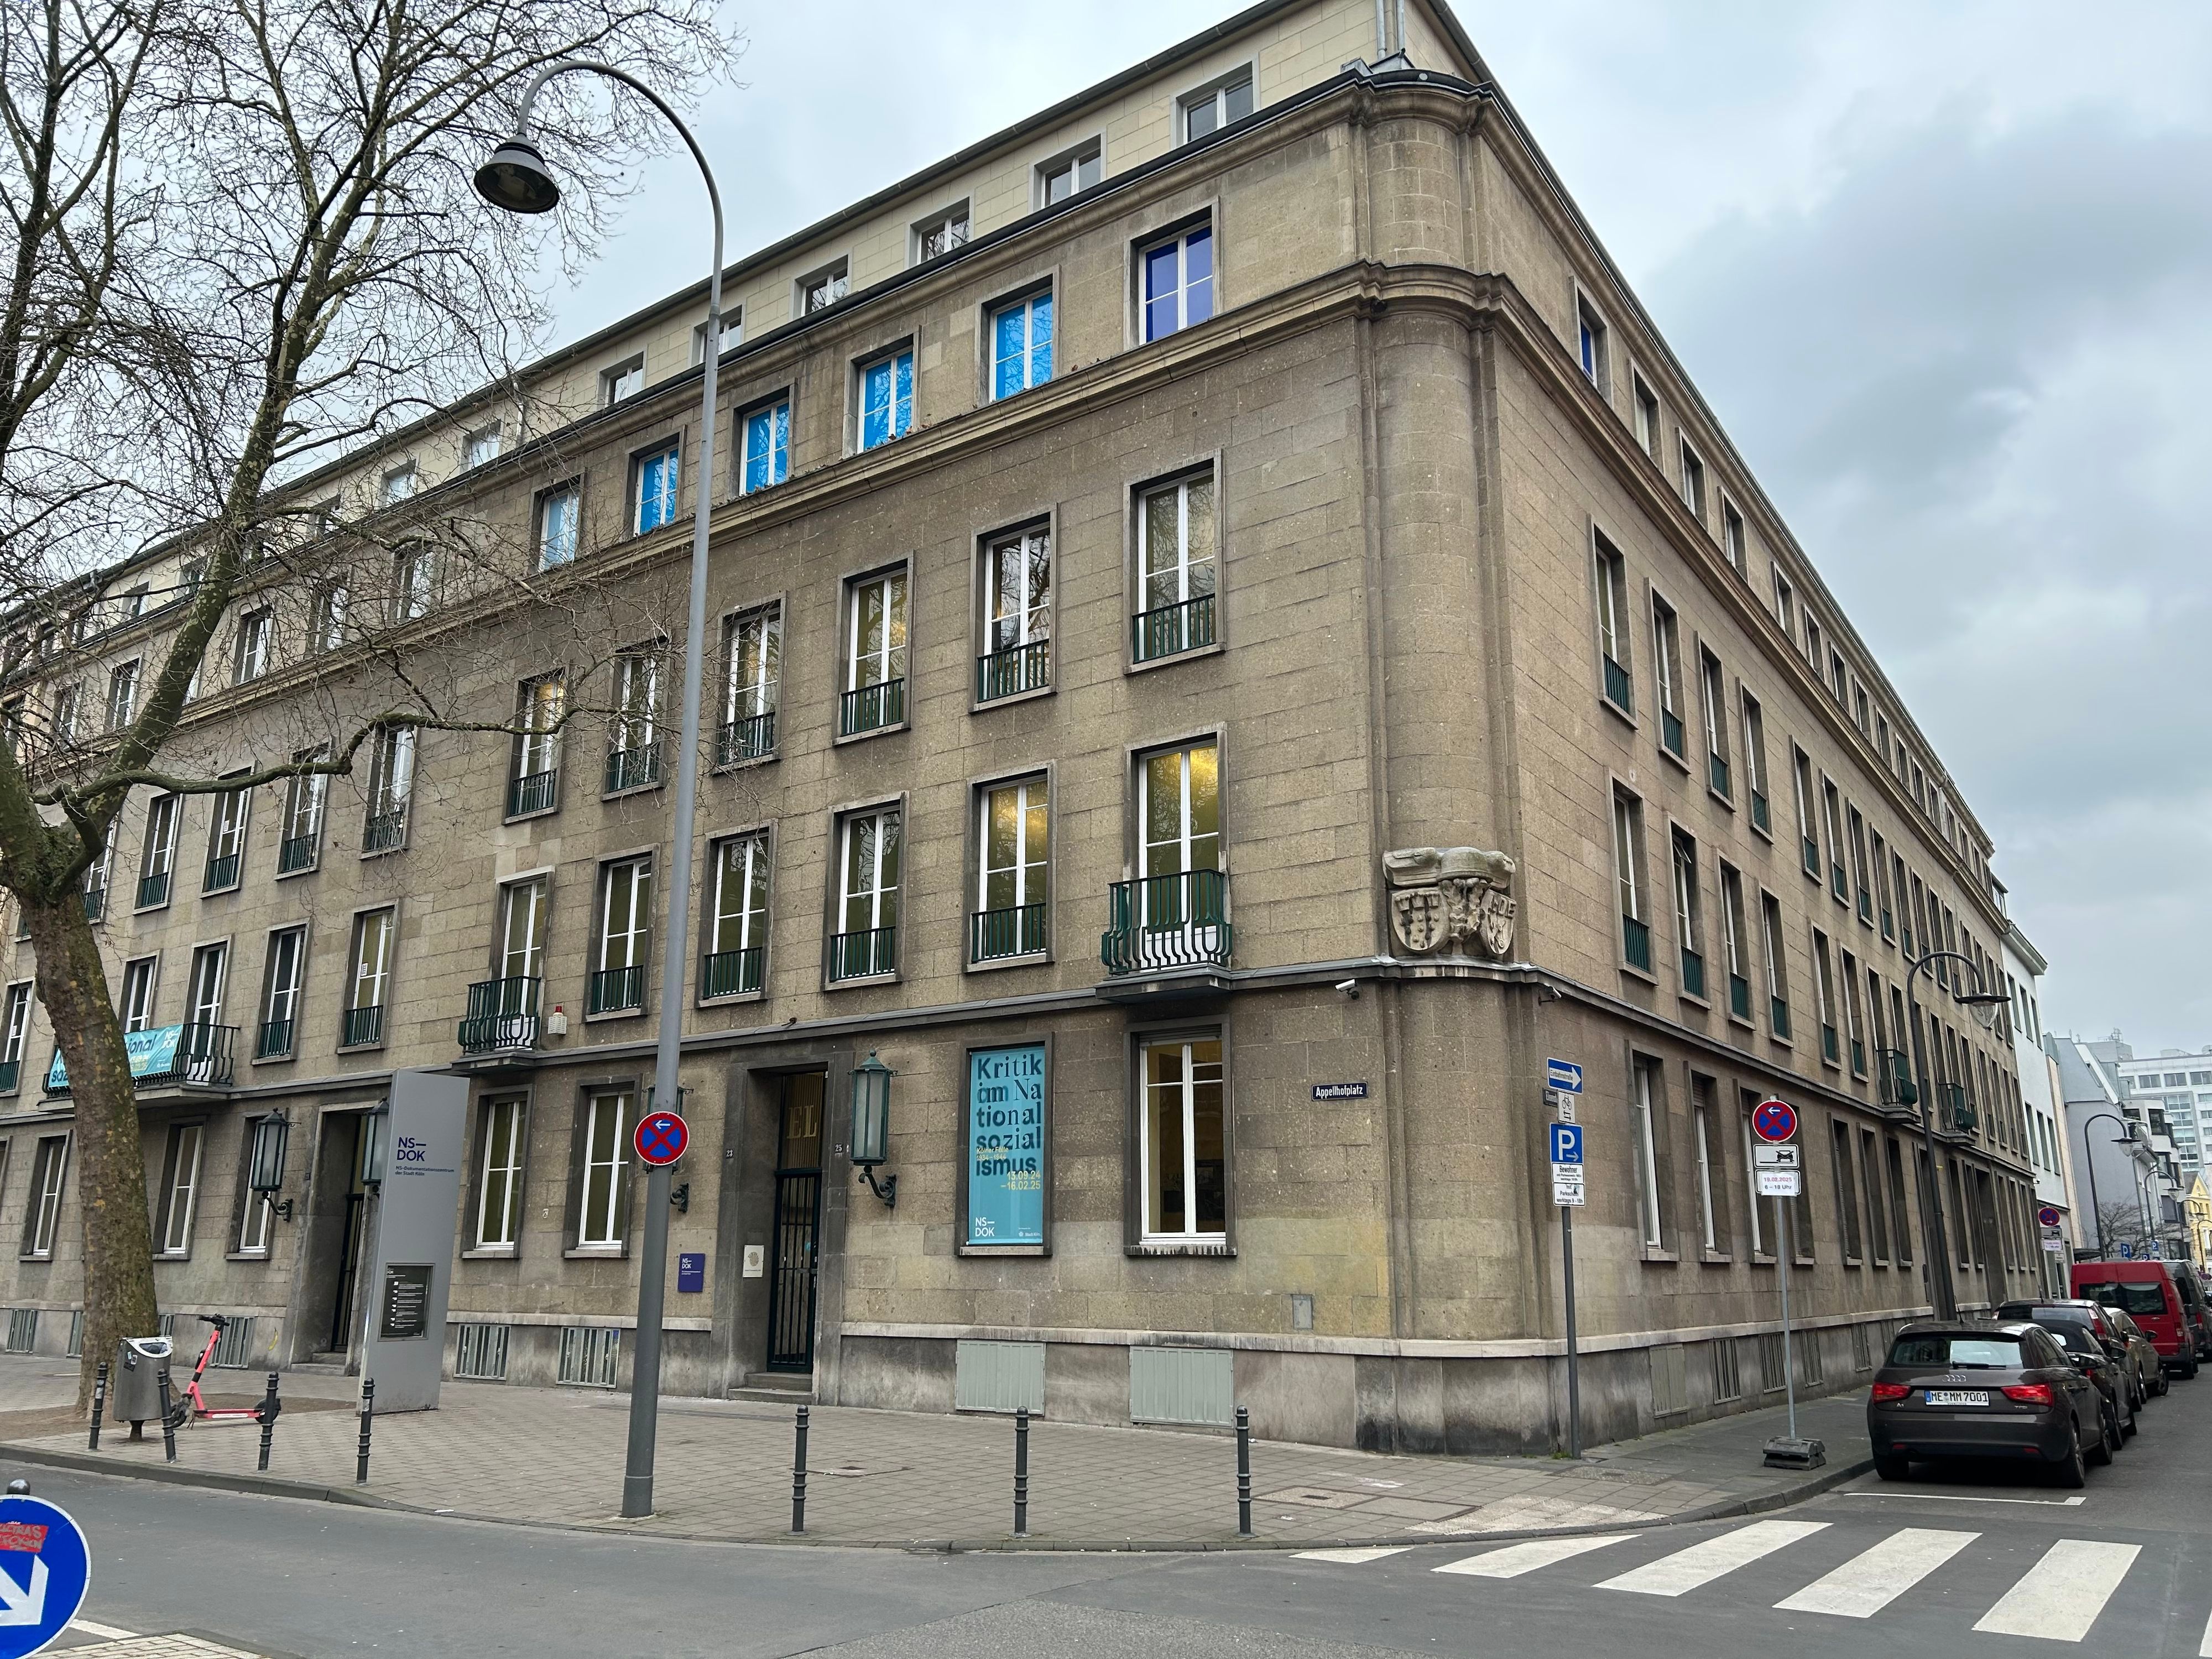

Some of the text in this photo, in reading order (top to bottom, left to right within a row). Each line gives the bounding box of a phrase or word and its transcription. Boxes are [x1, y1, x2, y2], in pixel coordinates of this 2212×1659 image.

[978, 1053, 1042, 1080] Kritik
[1014, 1078, 1042, 1100] Na
[1316, 1084, 1363, 1099] Appellhofplatz
[787, 1105, 817, 1139] EL
[977, 1101, 1041, 1128] tional
[977, 1126, 1041, 1151] sozial
[1558, 1129, 1575, 1160] P
[397, 1150, 425, 1161] DOK
[976, 1157, 1037, 1176] ismus
[1007, 1170, 1040, 1180] 13.09.24
[975, 1227, 995, 1237] DOK
[2123, 1245, 2128, 1258] P
[1932, 1392, 1987, 1402] ME MM 7001
